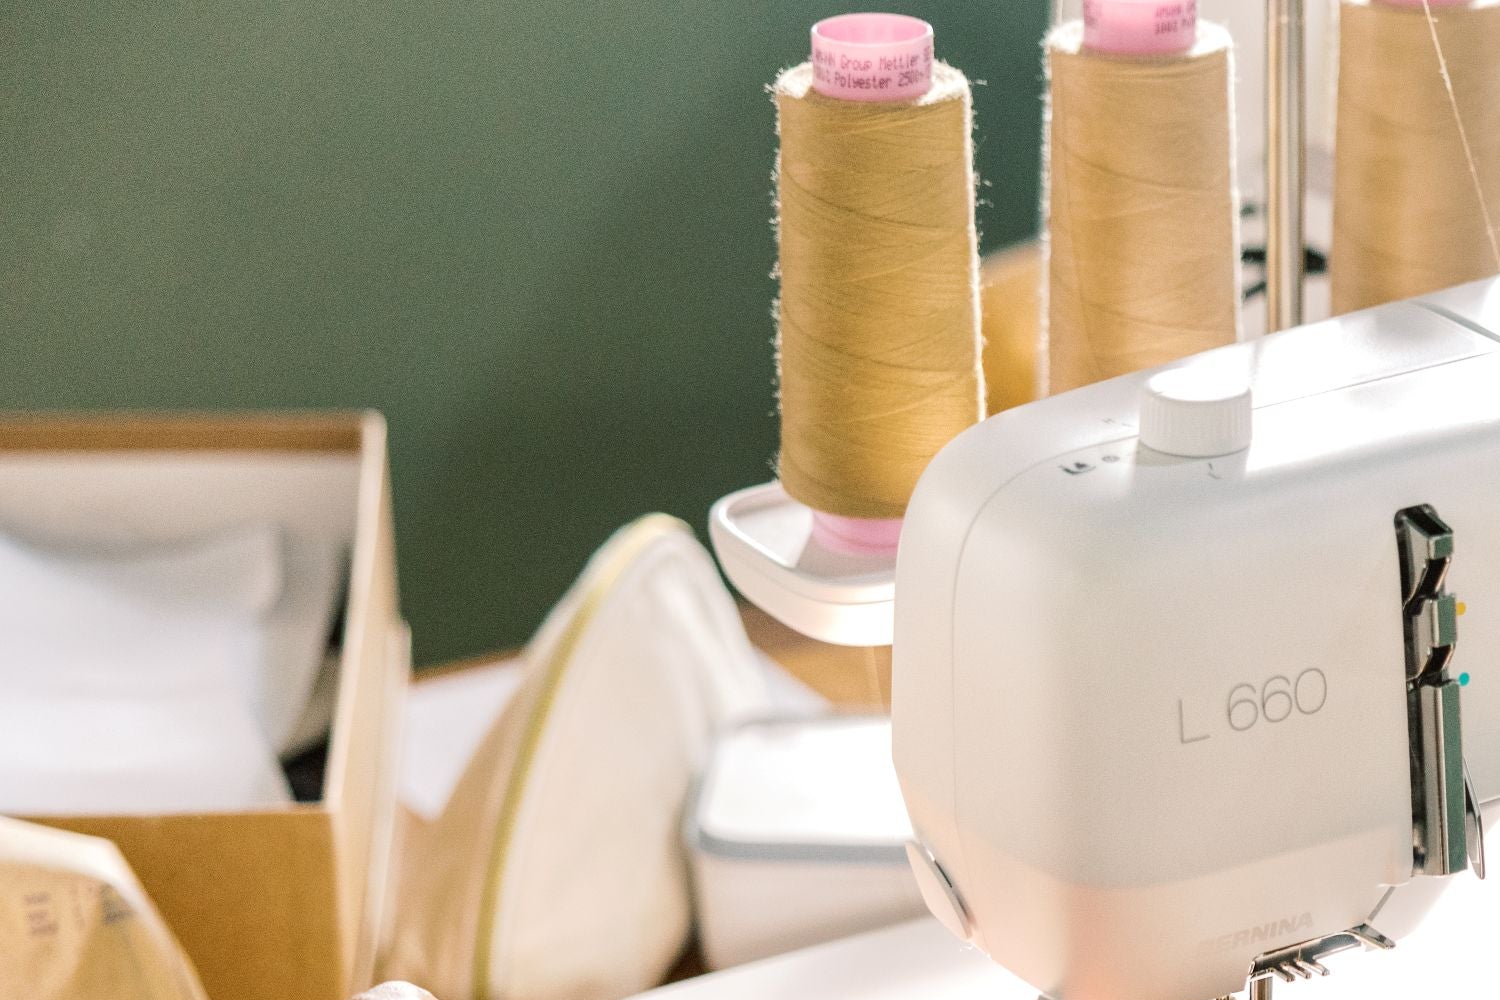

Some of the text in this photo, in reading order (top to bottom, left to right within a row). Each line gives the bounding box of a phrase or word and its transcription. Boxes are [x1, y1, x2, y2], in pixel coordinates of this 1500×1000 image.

[841, 54, 872, 71] Group
[879, 53, 919, 71] Mettler
[834, 71, 892, 89] Polyester
[1177, 667, 1328, 744] L 660
